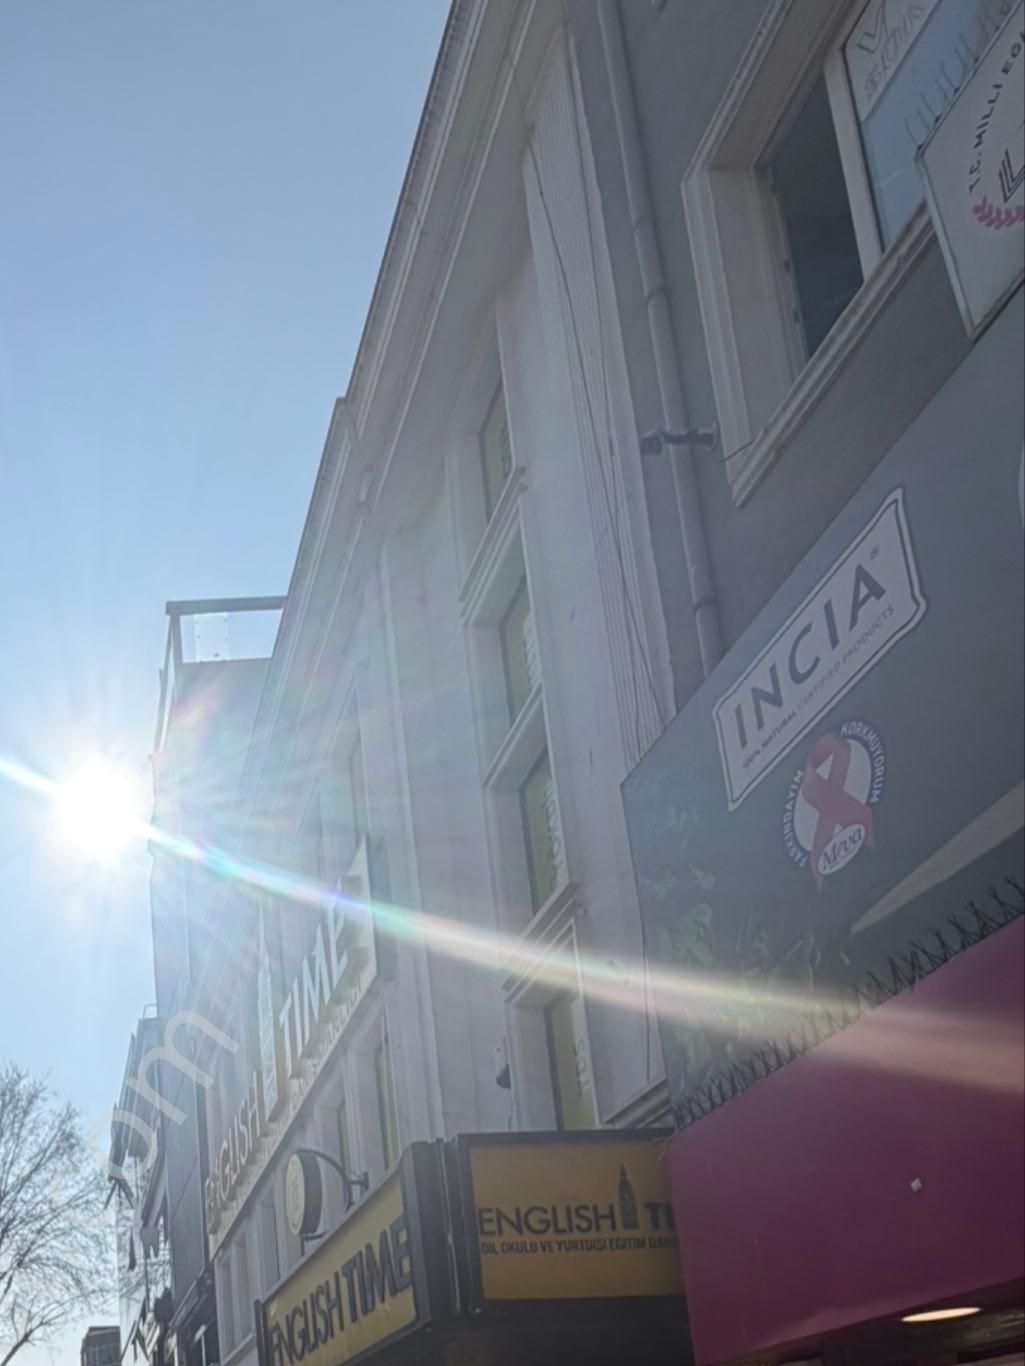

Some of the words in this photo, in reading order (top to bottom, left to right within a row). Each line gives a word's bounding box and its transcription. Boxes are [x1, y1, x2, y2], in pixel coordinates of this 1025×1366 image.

[736, 564, 887, 749] INCIA
[840, 720, 884, 804] KORKMUYORUM
[783, 769, 809, 868] FARKINDAYIM
[279, 876, 349, 1080] TIME
[341, 1213, 413, 1325] TIME
[478, 1203, 617, 1237] ENGLISH
[643, 1202, 677, 1231] TI
[501, 1239, 538, 1255] OKULU
[540, 1239, 554, 1254] VE
